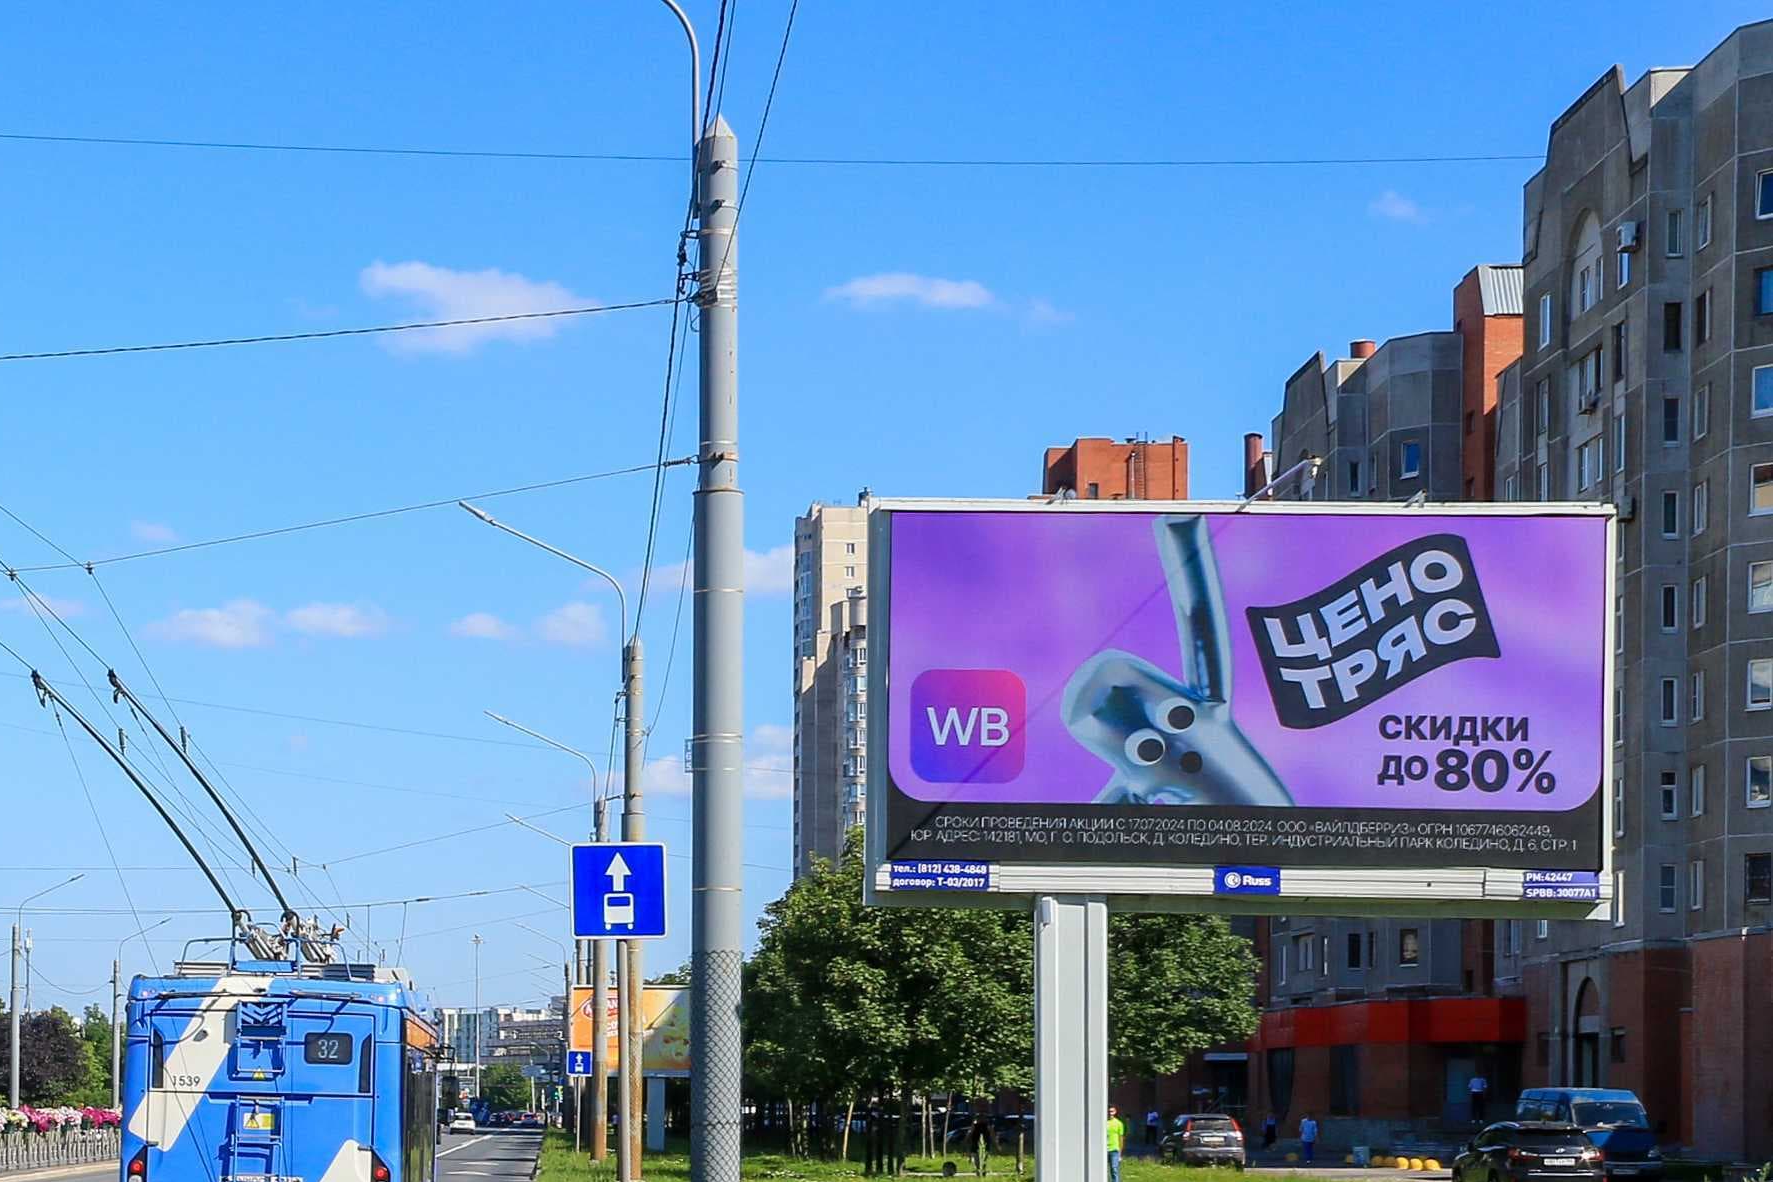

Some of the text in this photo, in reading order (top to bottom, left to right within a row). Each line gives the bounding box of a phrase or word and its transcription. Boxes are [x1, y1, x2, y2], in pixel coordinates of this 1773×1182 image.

[1263, 549, 1463, 661] ЦЕНО
[1279, 598, 1477, 709] ТРЯС
[926, 706, 1010, 747] WB
[1433, 748, 1556, 795] 80%
[934, 815, 979, 829] СРОКИ
[980, 816, 1067, 831] ПРОВЕДЕНИЯ
[1068, 817, 1114, 832] АКЦИИ
[1115, 818, 1126, 830] С
[1187, 819, 1206, 831] ПО
[1277, 820, 1307, 833] ООО
[1309, 819, 1416, 836] «ВАЙЛДБЕРРИЗ»
[1417, 823, 1453, 835] ОГРН
[1077, 831, 1151, 846] ПОДОЛЬСК,
[1168, 832, 1242, 847] КОЛЕДИНО,
[1271, 834, 1399, 849] ИНДУСТРИАЛЬНЫЙ
[1400, 836, 1435, 849] ПАРК
[1436, 837, 1512, 852] КОЛЕДИНО,
[1571, 839, 1578, 851] 1
[893, 864, 916, 873] тел.:
[892, 878, 936, 888] договор:
[1242, 874, 1272, 886] Russ
[317, 1039, 339, 1059] 32
[172, 1074, 201, 1088] 1539
